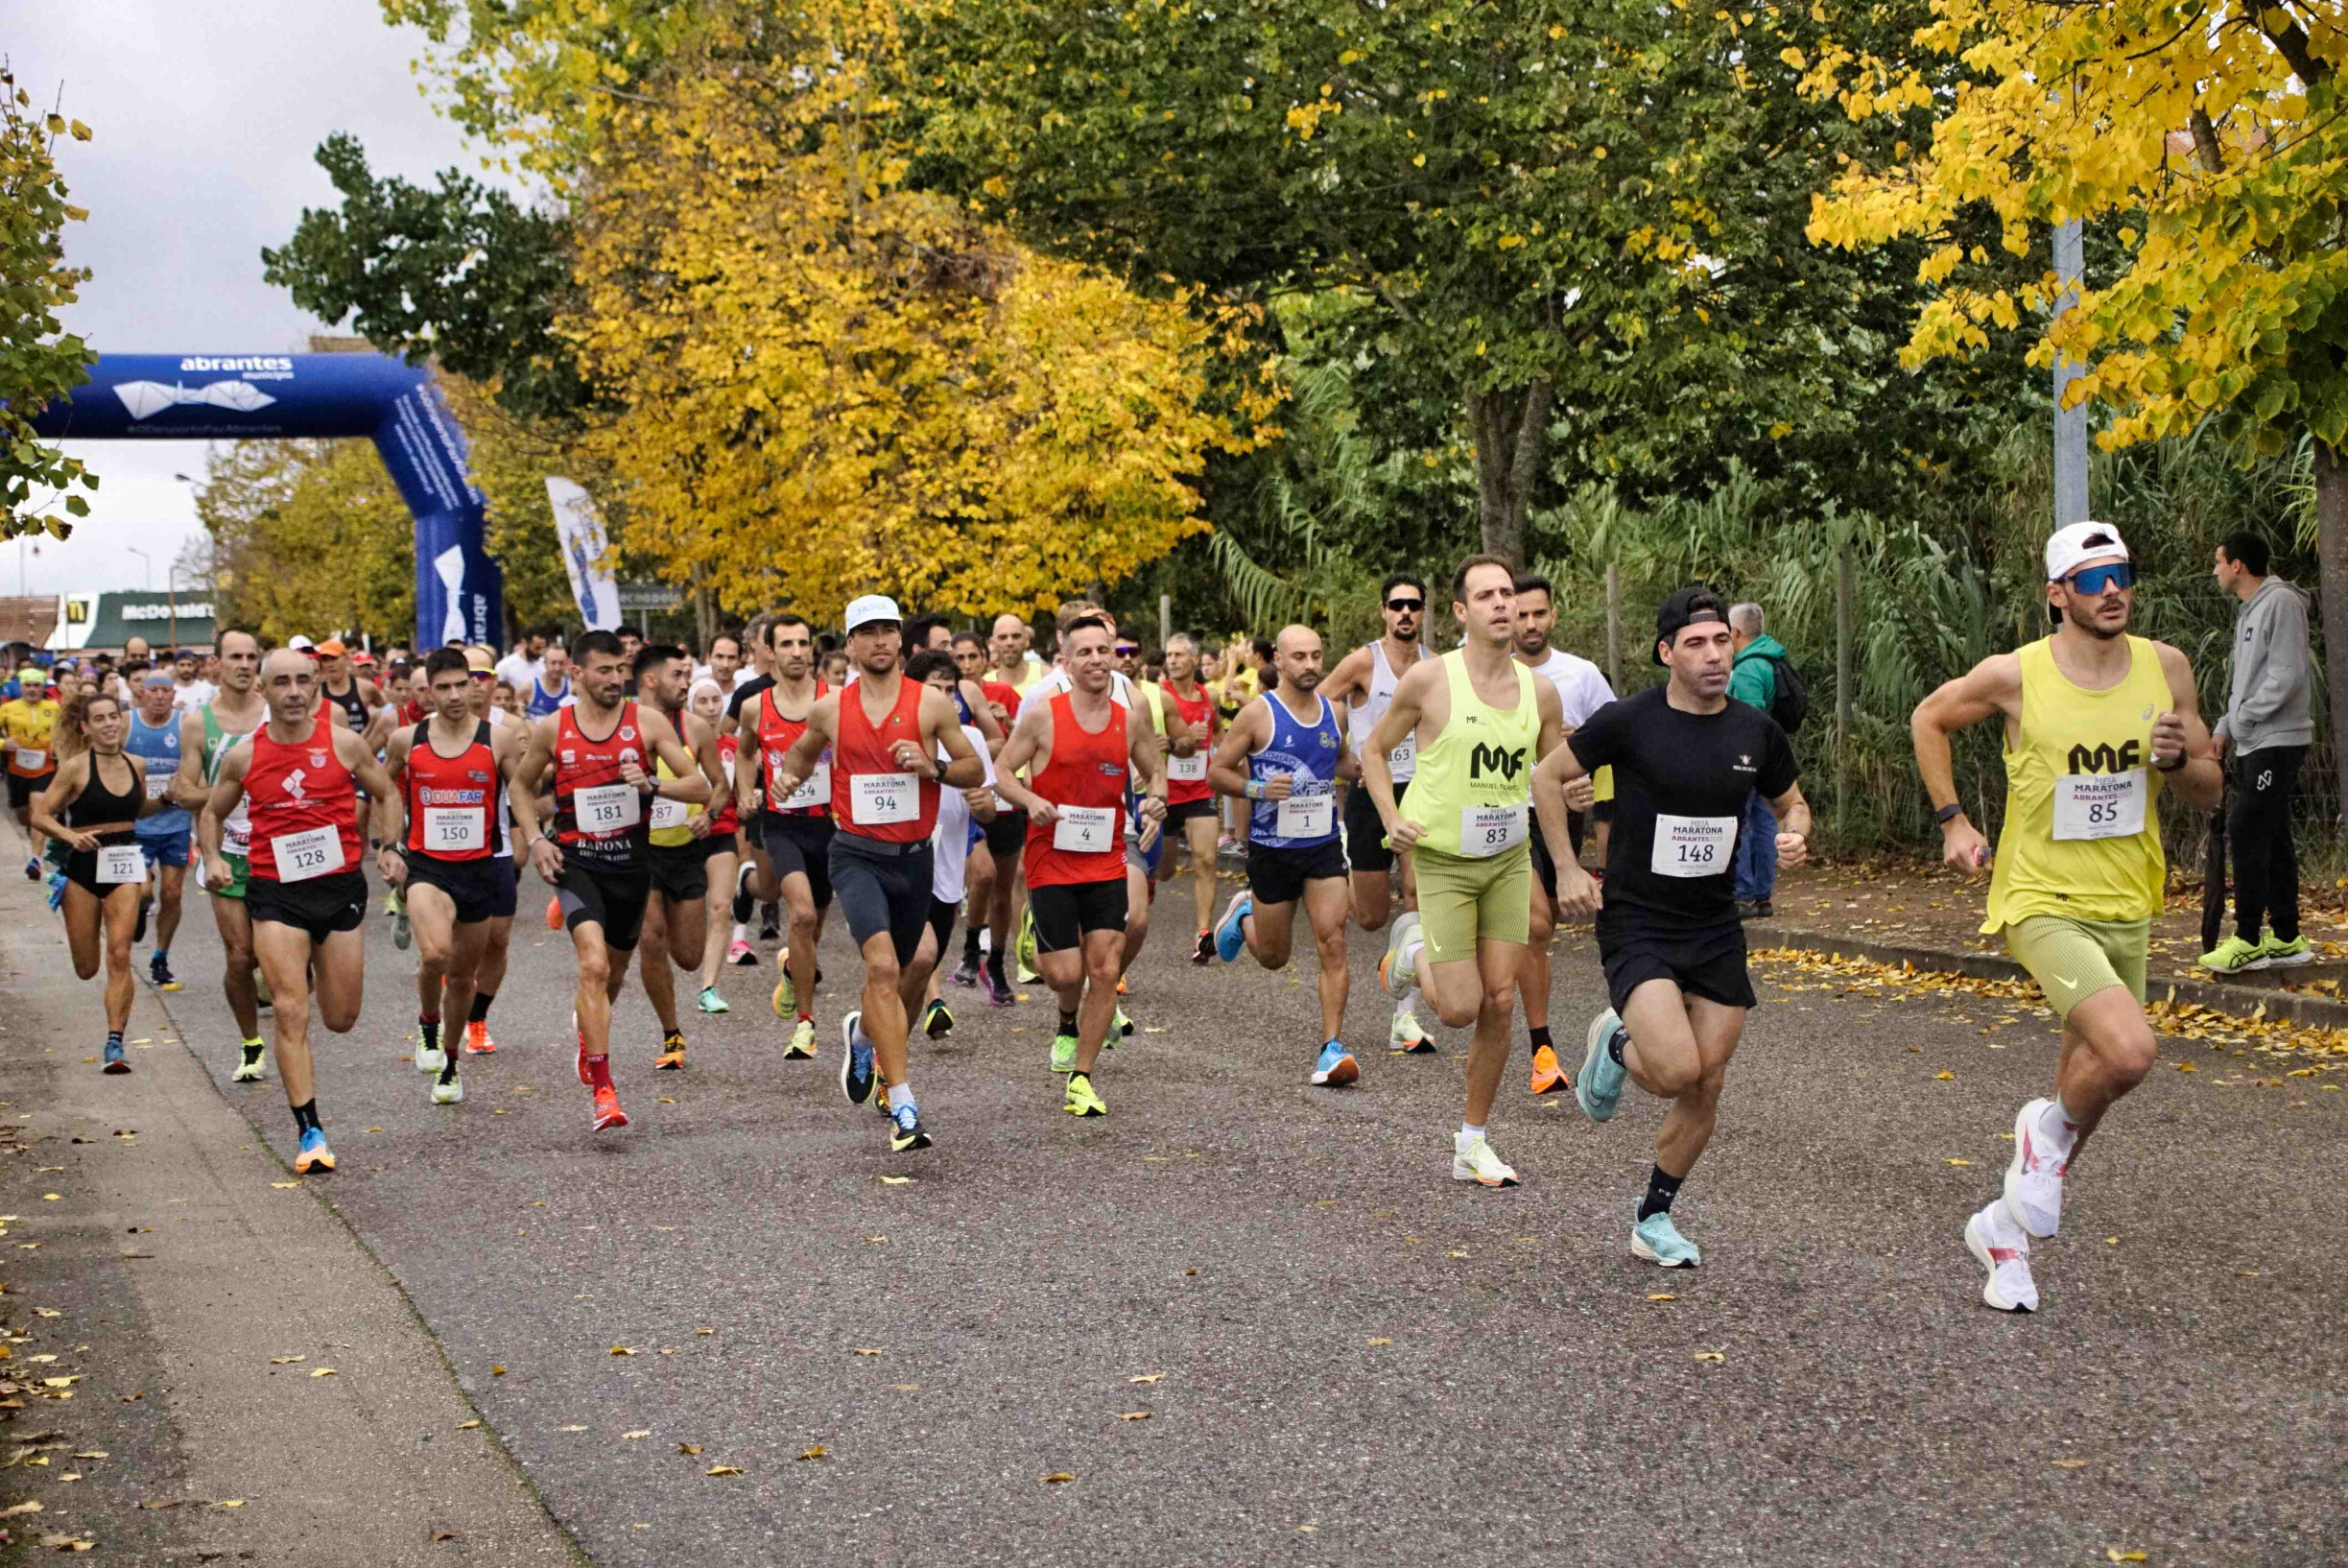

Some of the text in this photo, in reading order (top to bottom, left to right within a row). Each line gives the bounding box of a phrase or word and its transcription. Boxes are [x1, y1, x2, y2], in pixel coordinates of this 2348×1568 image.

[180, 356, 293, 371] abrantes
[1470, 742, 1528, 782] MF
[2068, 739, 2140, 775] MF
[1179, 764, 1198, 773] 138
[2075, 780, 2133, 793] MARATONA
[2095, 776, 2117, 785] MEIA
[874, 796, 897, 811] 94
[594, 805, 623, 820] 181
[1476, 811, 1517, 821] MARATONA
[2089, 800, 2118, 823] 85
[1304, 815, 1311, 828] 1
[441, 826, 468, 840] 150
[1081, 827, 1092, 842] 4
[1485, 828, 1507, 843] 83
[285, 835, 326, 849] MARATONA
[577, 839, 633, 851] BARONA
[295, 849, 325, 868] 128
[1677, 844, 1714, 862] 148
[112, 863, 134, 874] 121
